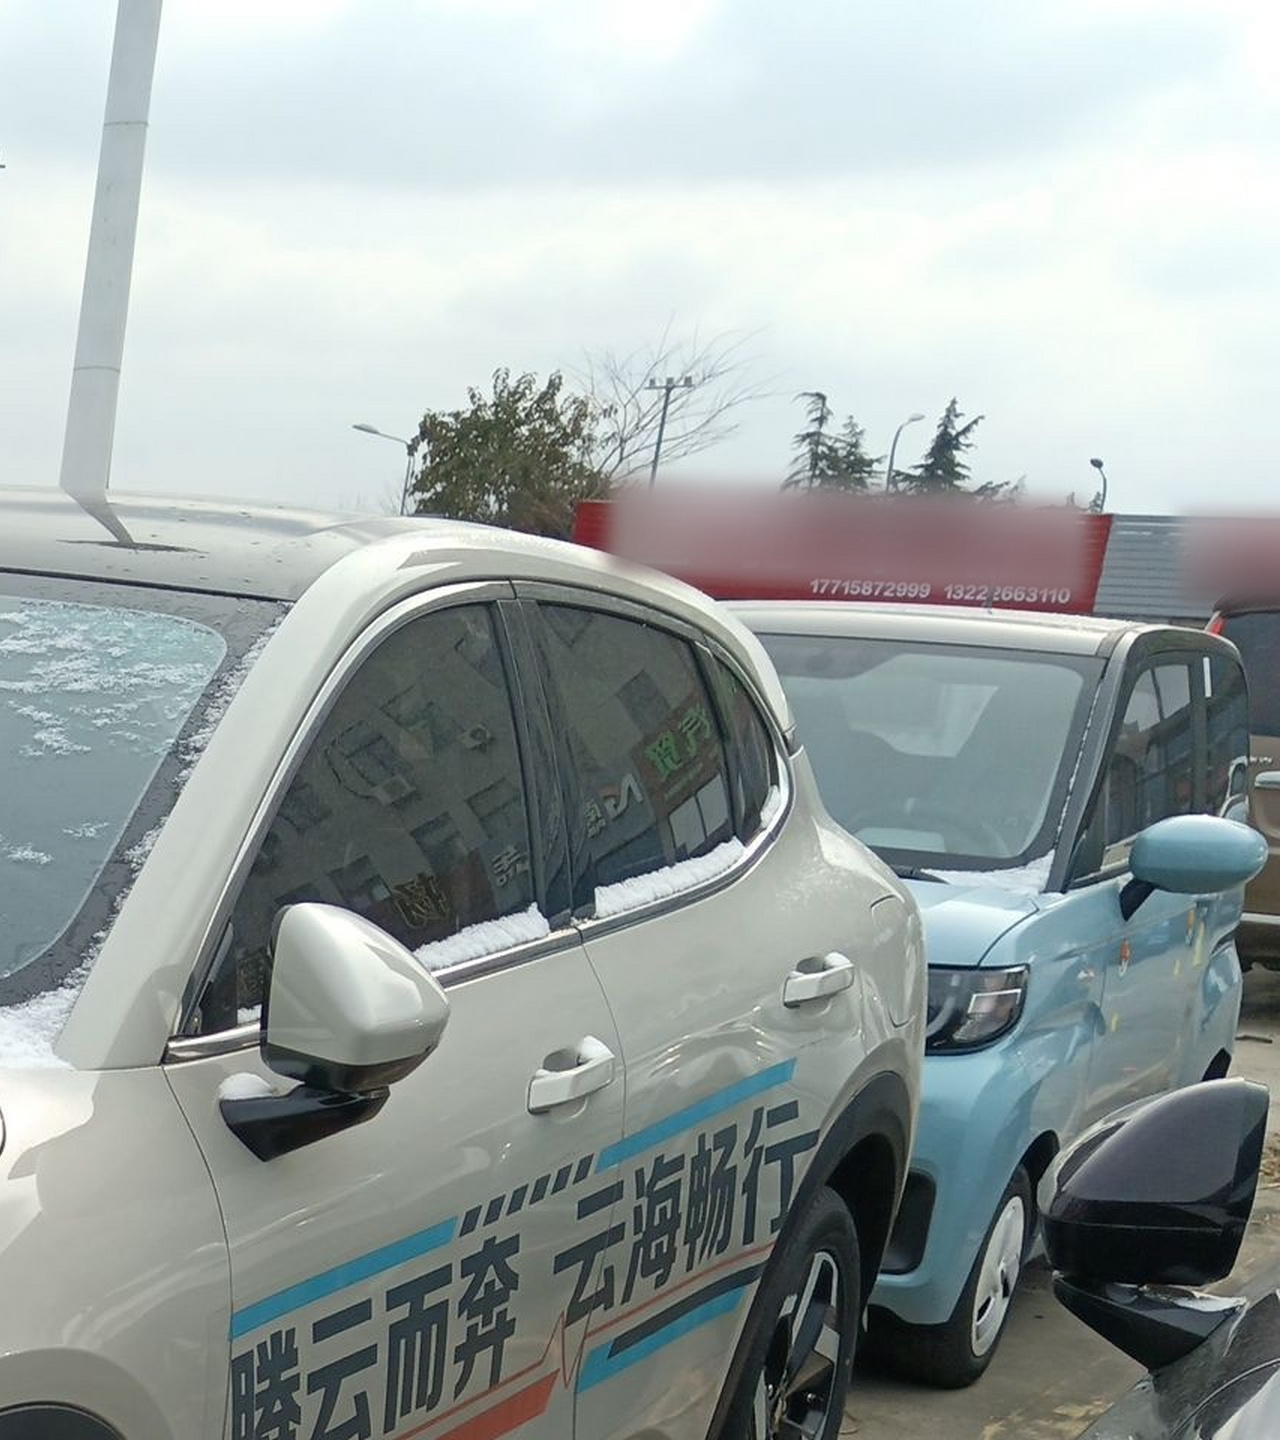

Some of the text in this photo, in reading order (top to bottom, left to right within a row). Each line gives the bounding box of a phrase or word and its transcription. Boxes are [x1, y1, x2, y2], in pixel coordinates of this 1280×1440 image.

[809, 578, 931, 599] 17715872999
[553, 1100, 821, 1329] 云海畅行
